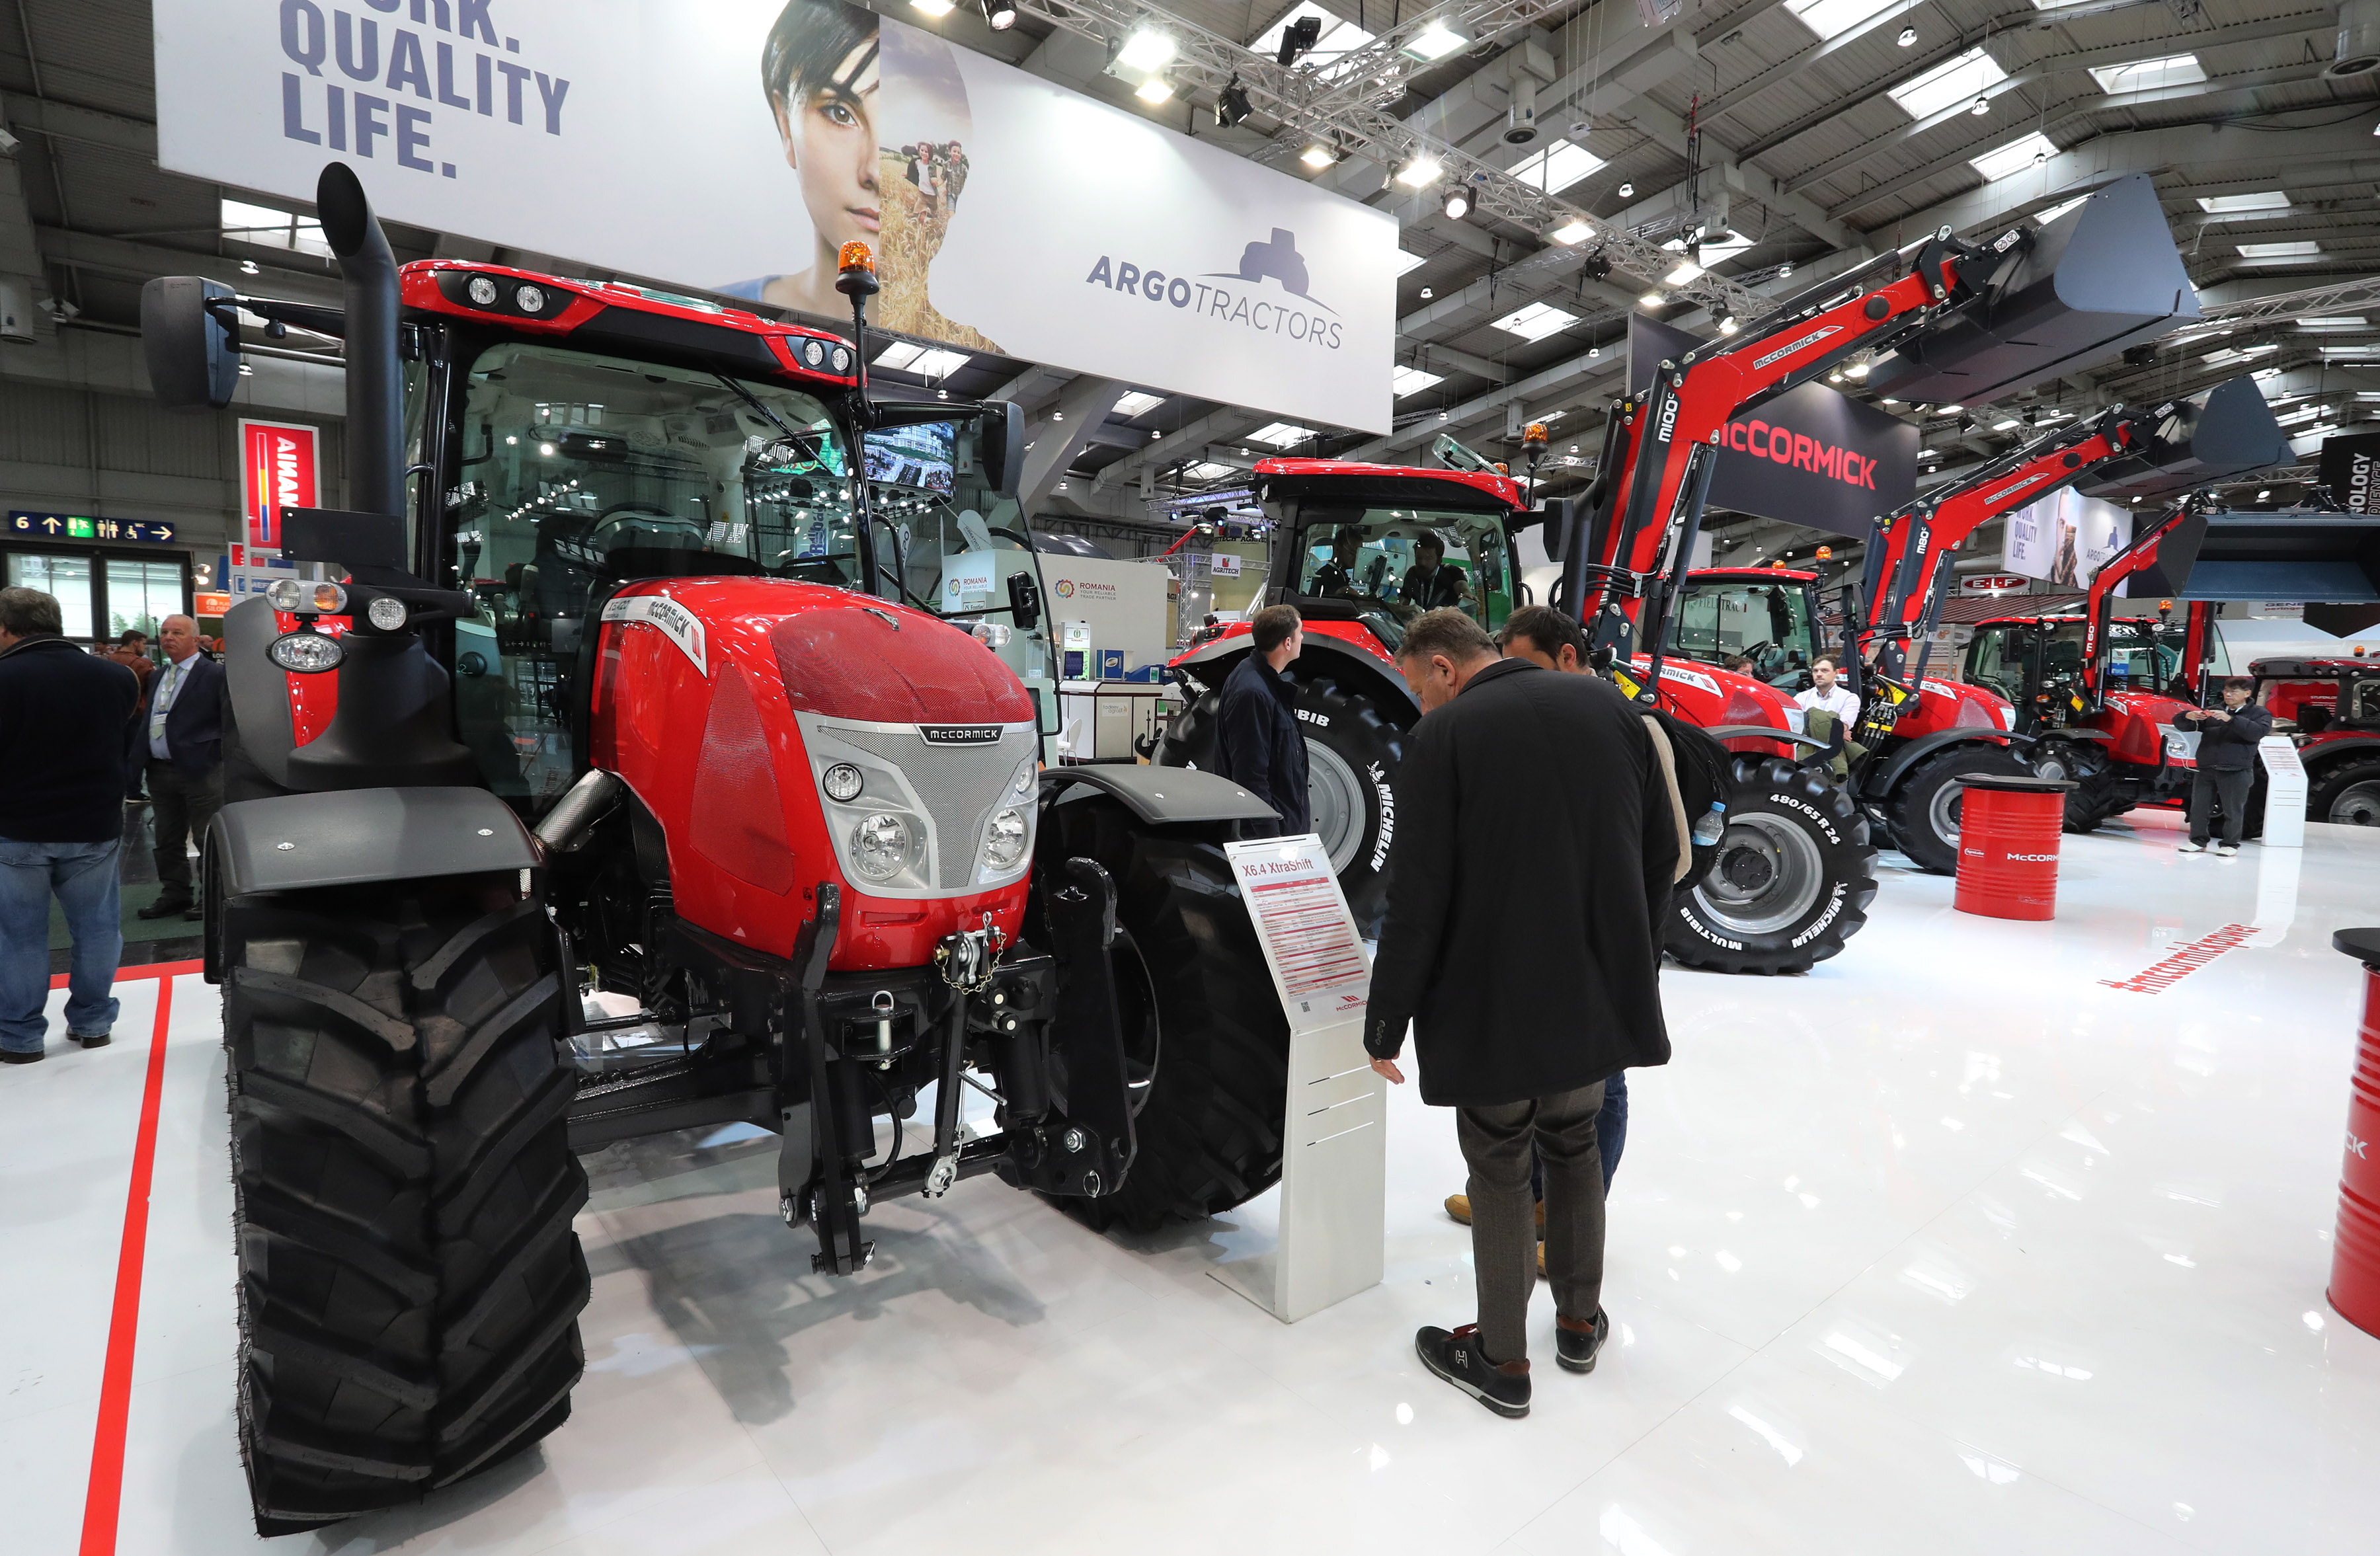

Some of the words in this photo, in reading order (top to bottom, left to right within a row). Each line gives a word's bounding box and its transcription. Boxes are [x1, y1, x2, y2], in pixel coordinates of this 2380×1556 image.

[280, 0, 570, 136] QUALITY
[282, 72, 456, 179] LIFE.
[1086, 255, 1343, 350] ARGOTRACTORS
[16, 516, 29, 529] 6
[2014, 520, 2038, 543] QUALITY
[2012, 541, 2026, 561] LIFE.
[963, 576, 988, 586] ROMANIA
[1080, 582, 1116, 592] ROMANIA
[930, 730, 998, 739] McCORMICK
[1370, 784, 1394, 873] MICHELIN
[1770, 794, 1821, 820] 480/65
[1817, 818, 1830, 829] R
[1825, 828, 1841, 845] 24
[1242, 863, 1267, 876] X6.4
[1267, 859, 1314, 873] XtraShift
[1680, 907, 1743, 951] MULTIBIB
[1792, 897, 1843, 949] MICHELIN
